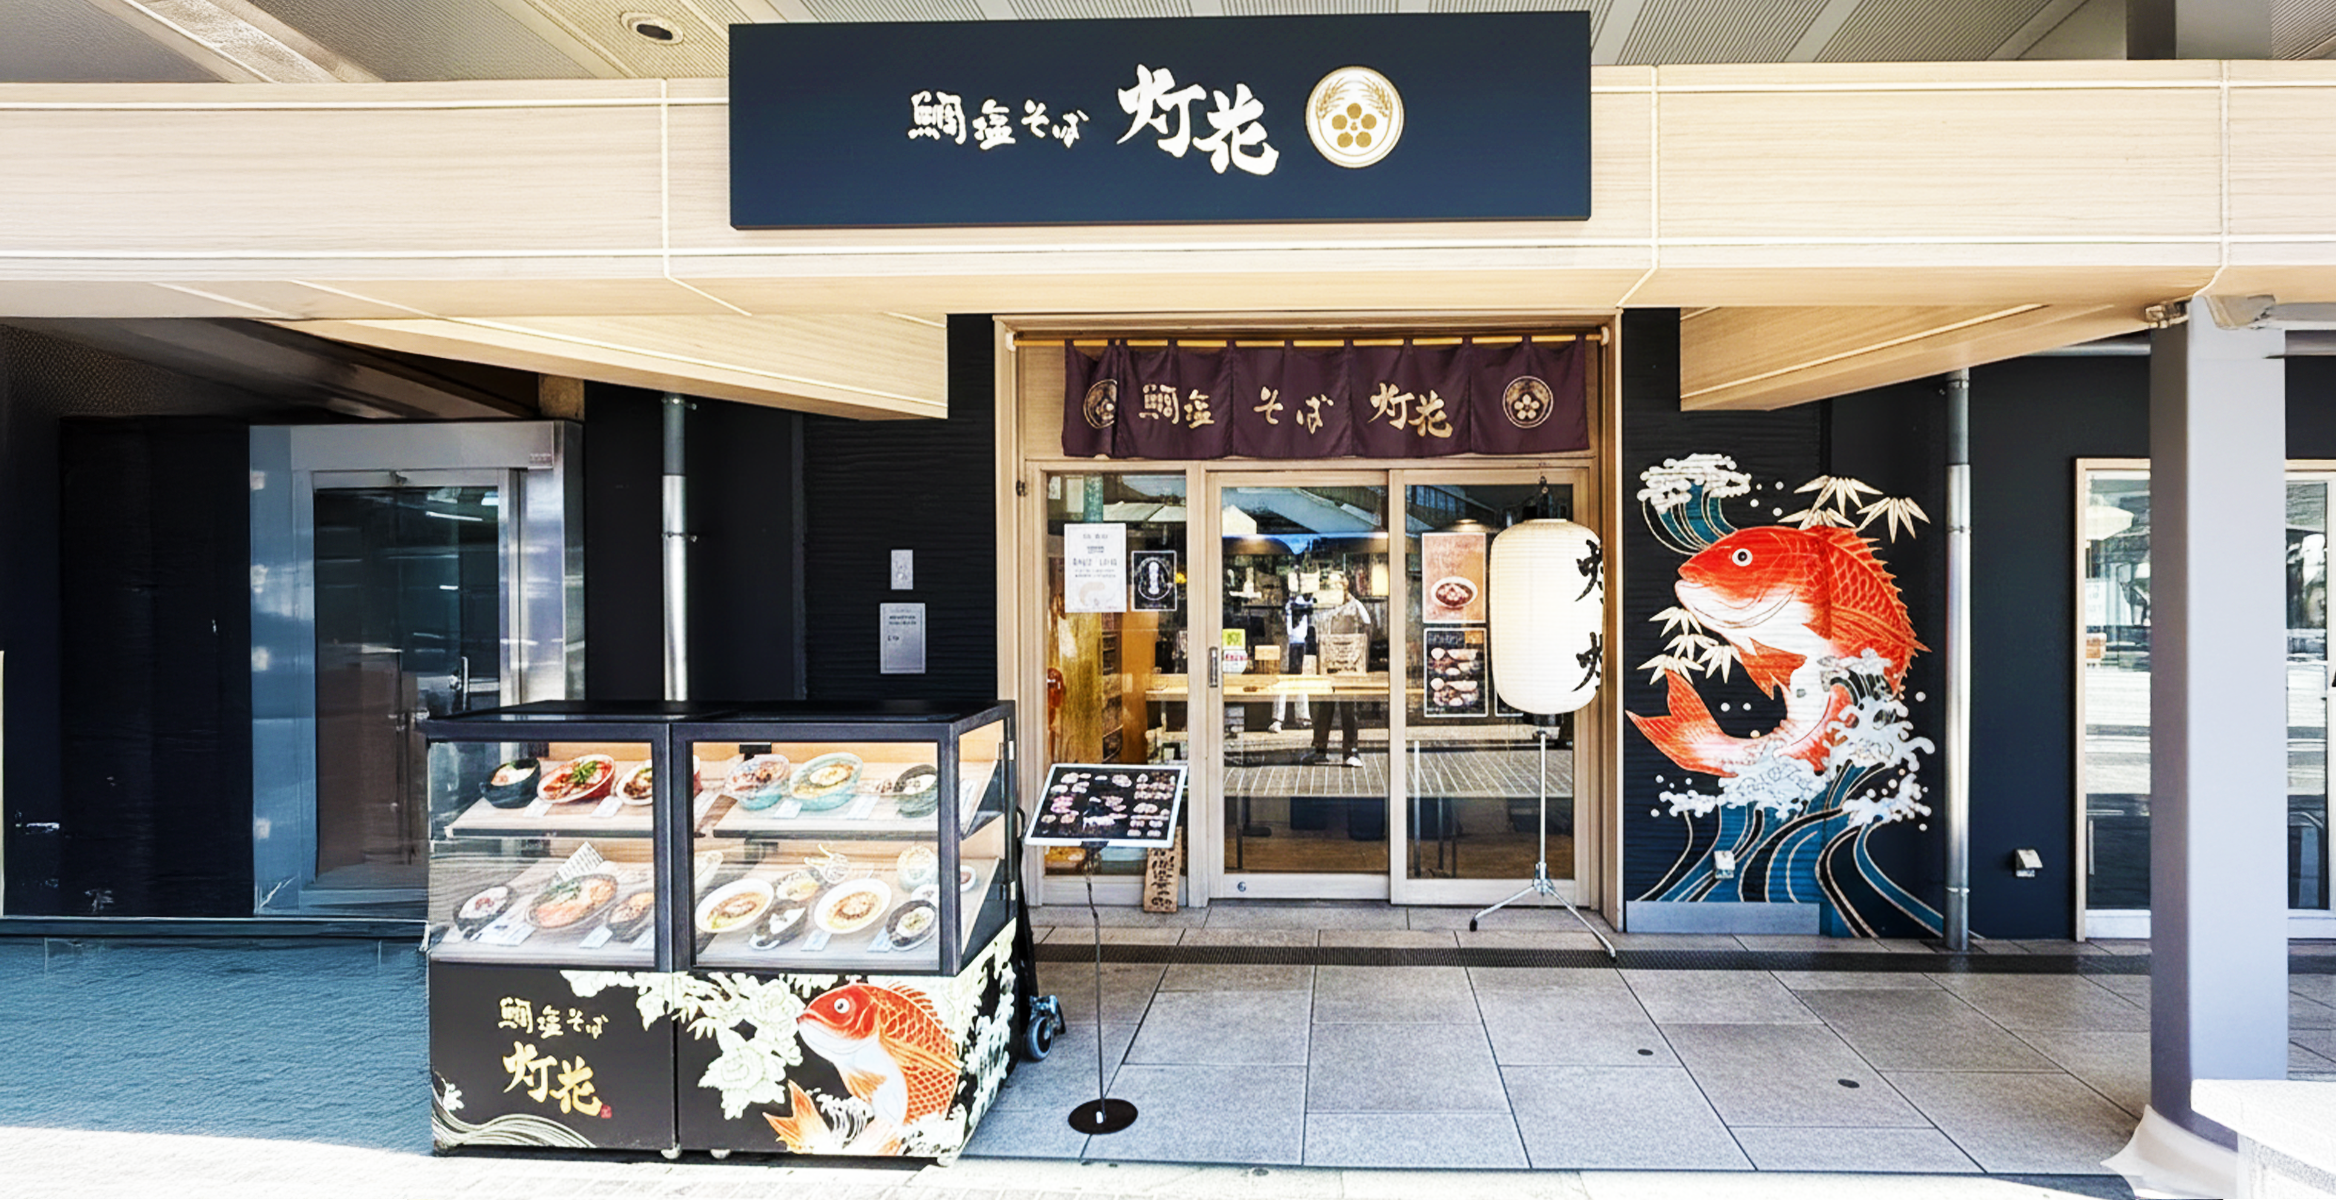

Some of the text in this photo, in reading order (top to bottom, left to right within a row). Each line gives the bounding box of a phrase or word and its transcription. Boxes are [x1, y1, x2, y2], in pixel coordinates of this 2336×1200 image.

[908, 64, 1280, 175] 鯛塩そば 灯花
[1369, 382, 1454, 438] 灯花
[498, 997, 609, 1039] 鯛塩そば
[502, 1041, 603, 1116] 灯花
